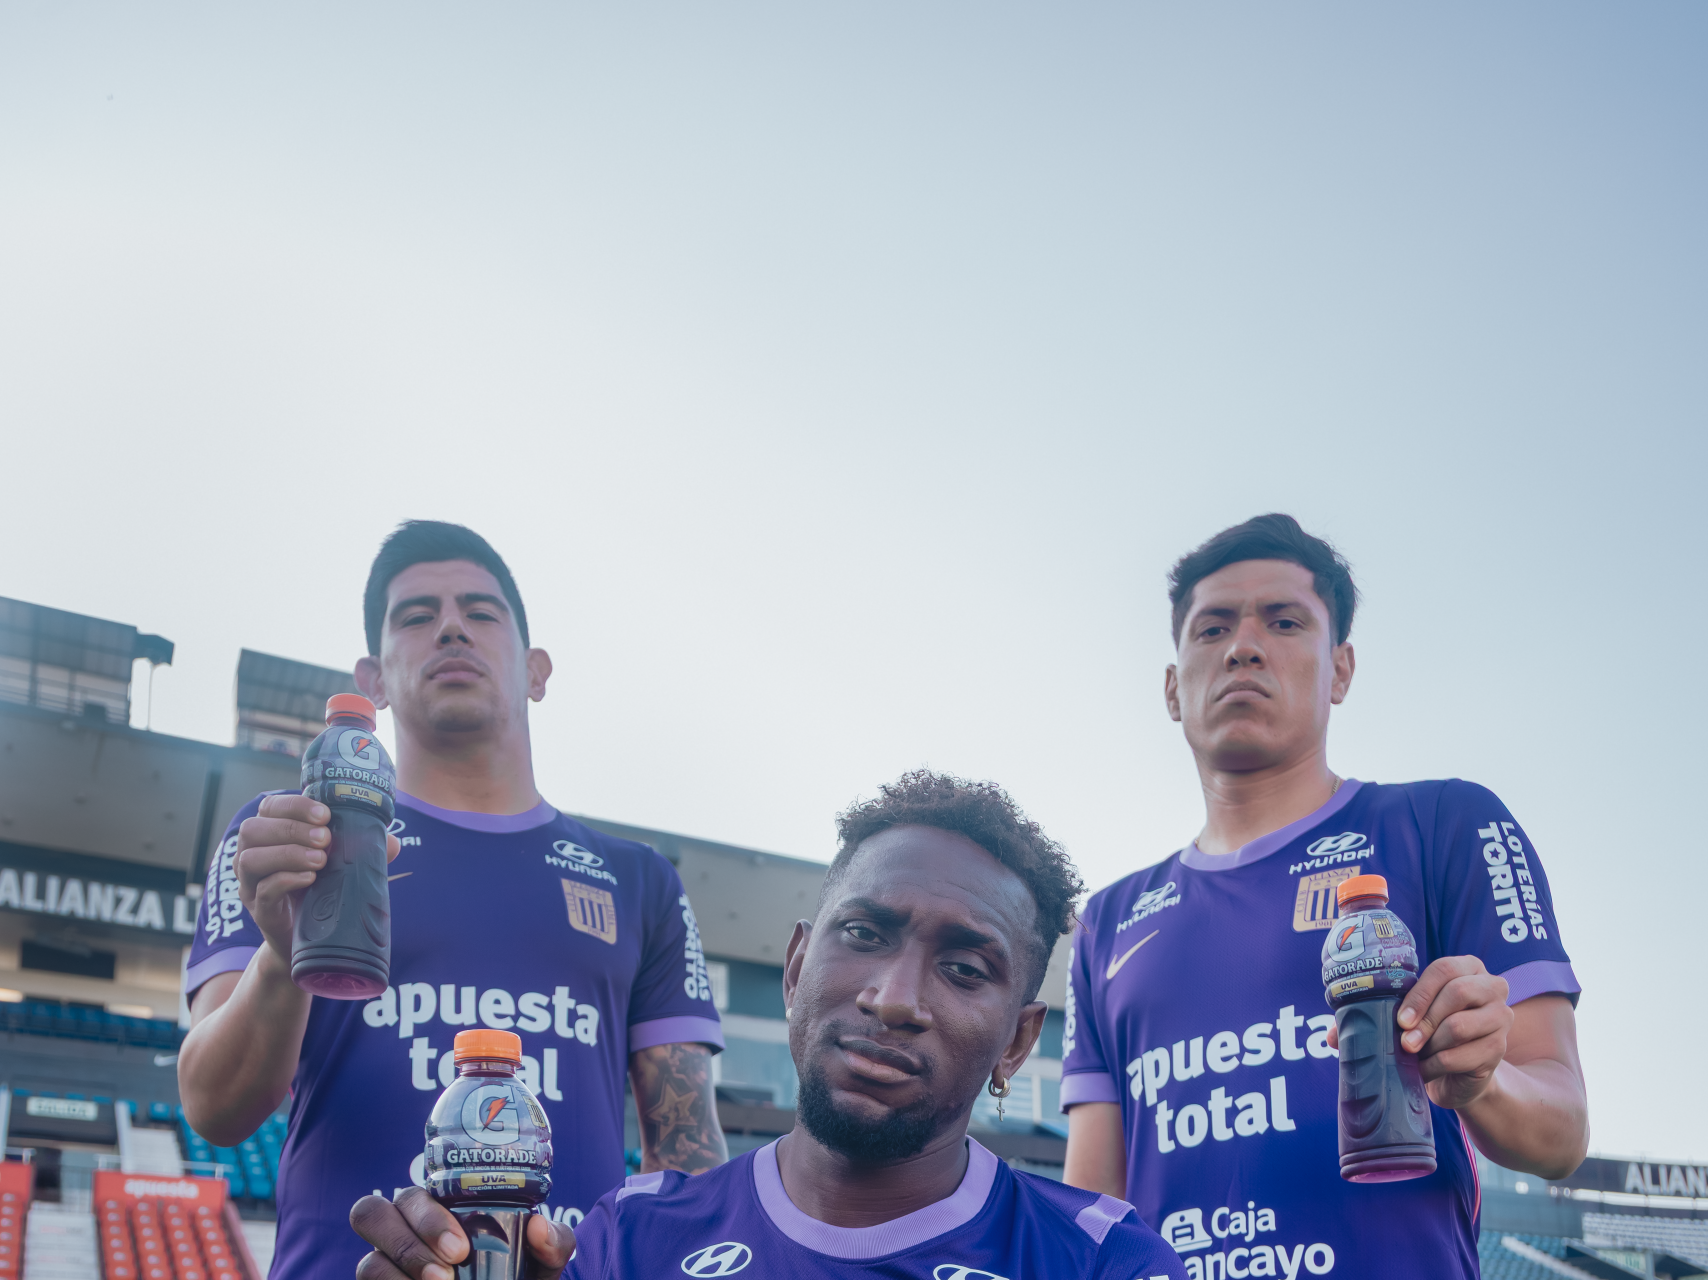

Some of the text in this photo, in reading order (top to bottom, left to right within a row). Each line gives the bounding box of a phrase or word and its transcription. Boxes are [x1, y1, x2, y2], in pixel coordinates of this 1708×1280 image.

[325, 767, 391, 792] GATORADE
[351, 788, 370, 798] UVA
[545, 854, 618, 886] HYUNDAI
[1289, 844, 1374, 875] HYUNDAI
[0, 867, 166, 930] ALIANZA
[1478, 821, 1528, 943] TORITO
[1500, 821, 1548, 940] LOTERÍAS
[1116, 893, 1181, 933] HYUNDAI
[1324, 957, 1383, 982] GATORADE
[1340, 981, 1358, 990] UVA
[362, 982, 599, 1047] apuesta
[1126, 1004, 1340, 1107] apuesta
[461, 1084, 520, 1146] G
[1155, 1075, 1296, 1154] total
[446, 1148, 537, 1164] GATORADE
[481, 1175, 507, 1183] UVA
[1625, 1162, 1708, 1198] ALIAN
[1211, 1201, 1277, 1242] Caja
